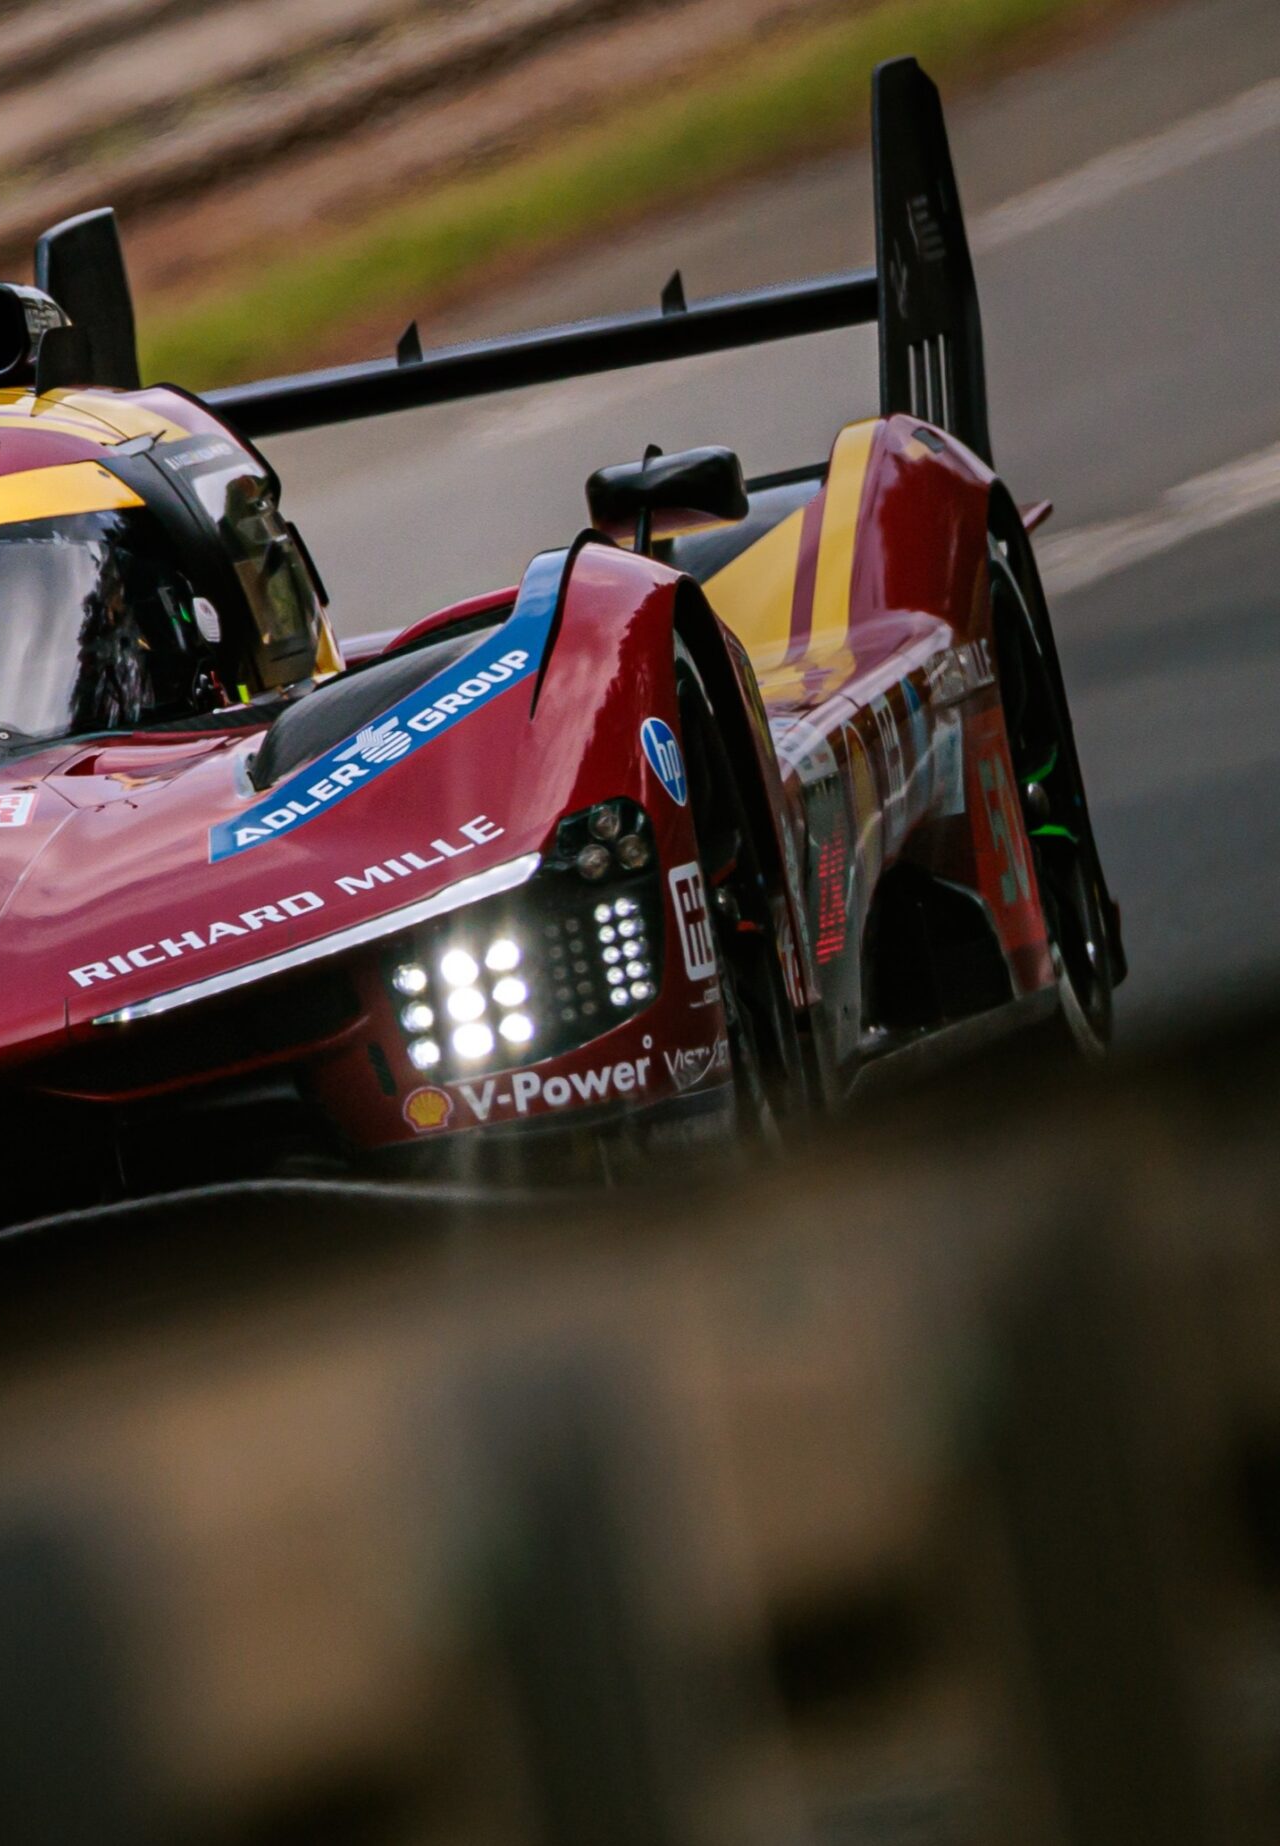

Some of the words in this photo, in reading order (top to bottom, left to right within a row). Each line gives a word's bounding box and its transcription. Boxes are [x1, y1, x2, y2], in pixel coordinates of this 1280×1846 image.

[232, 762, 371, 847] ADLER
[407, 649, 530, 732] GROUP
[67, 890, 325, 988] RICHARD
[334, 814, 507, 896] MILLE
[457, 1056, 651, 1121] V-Power
